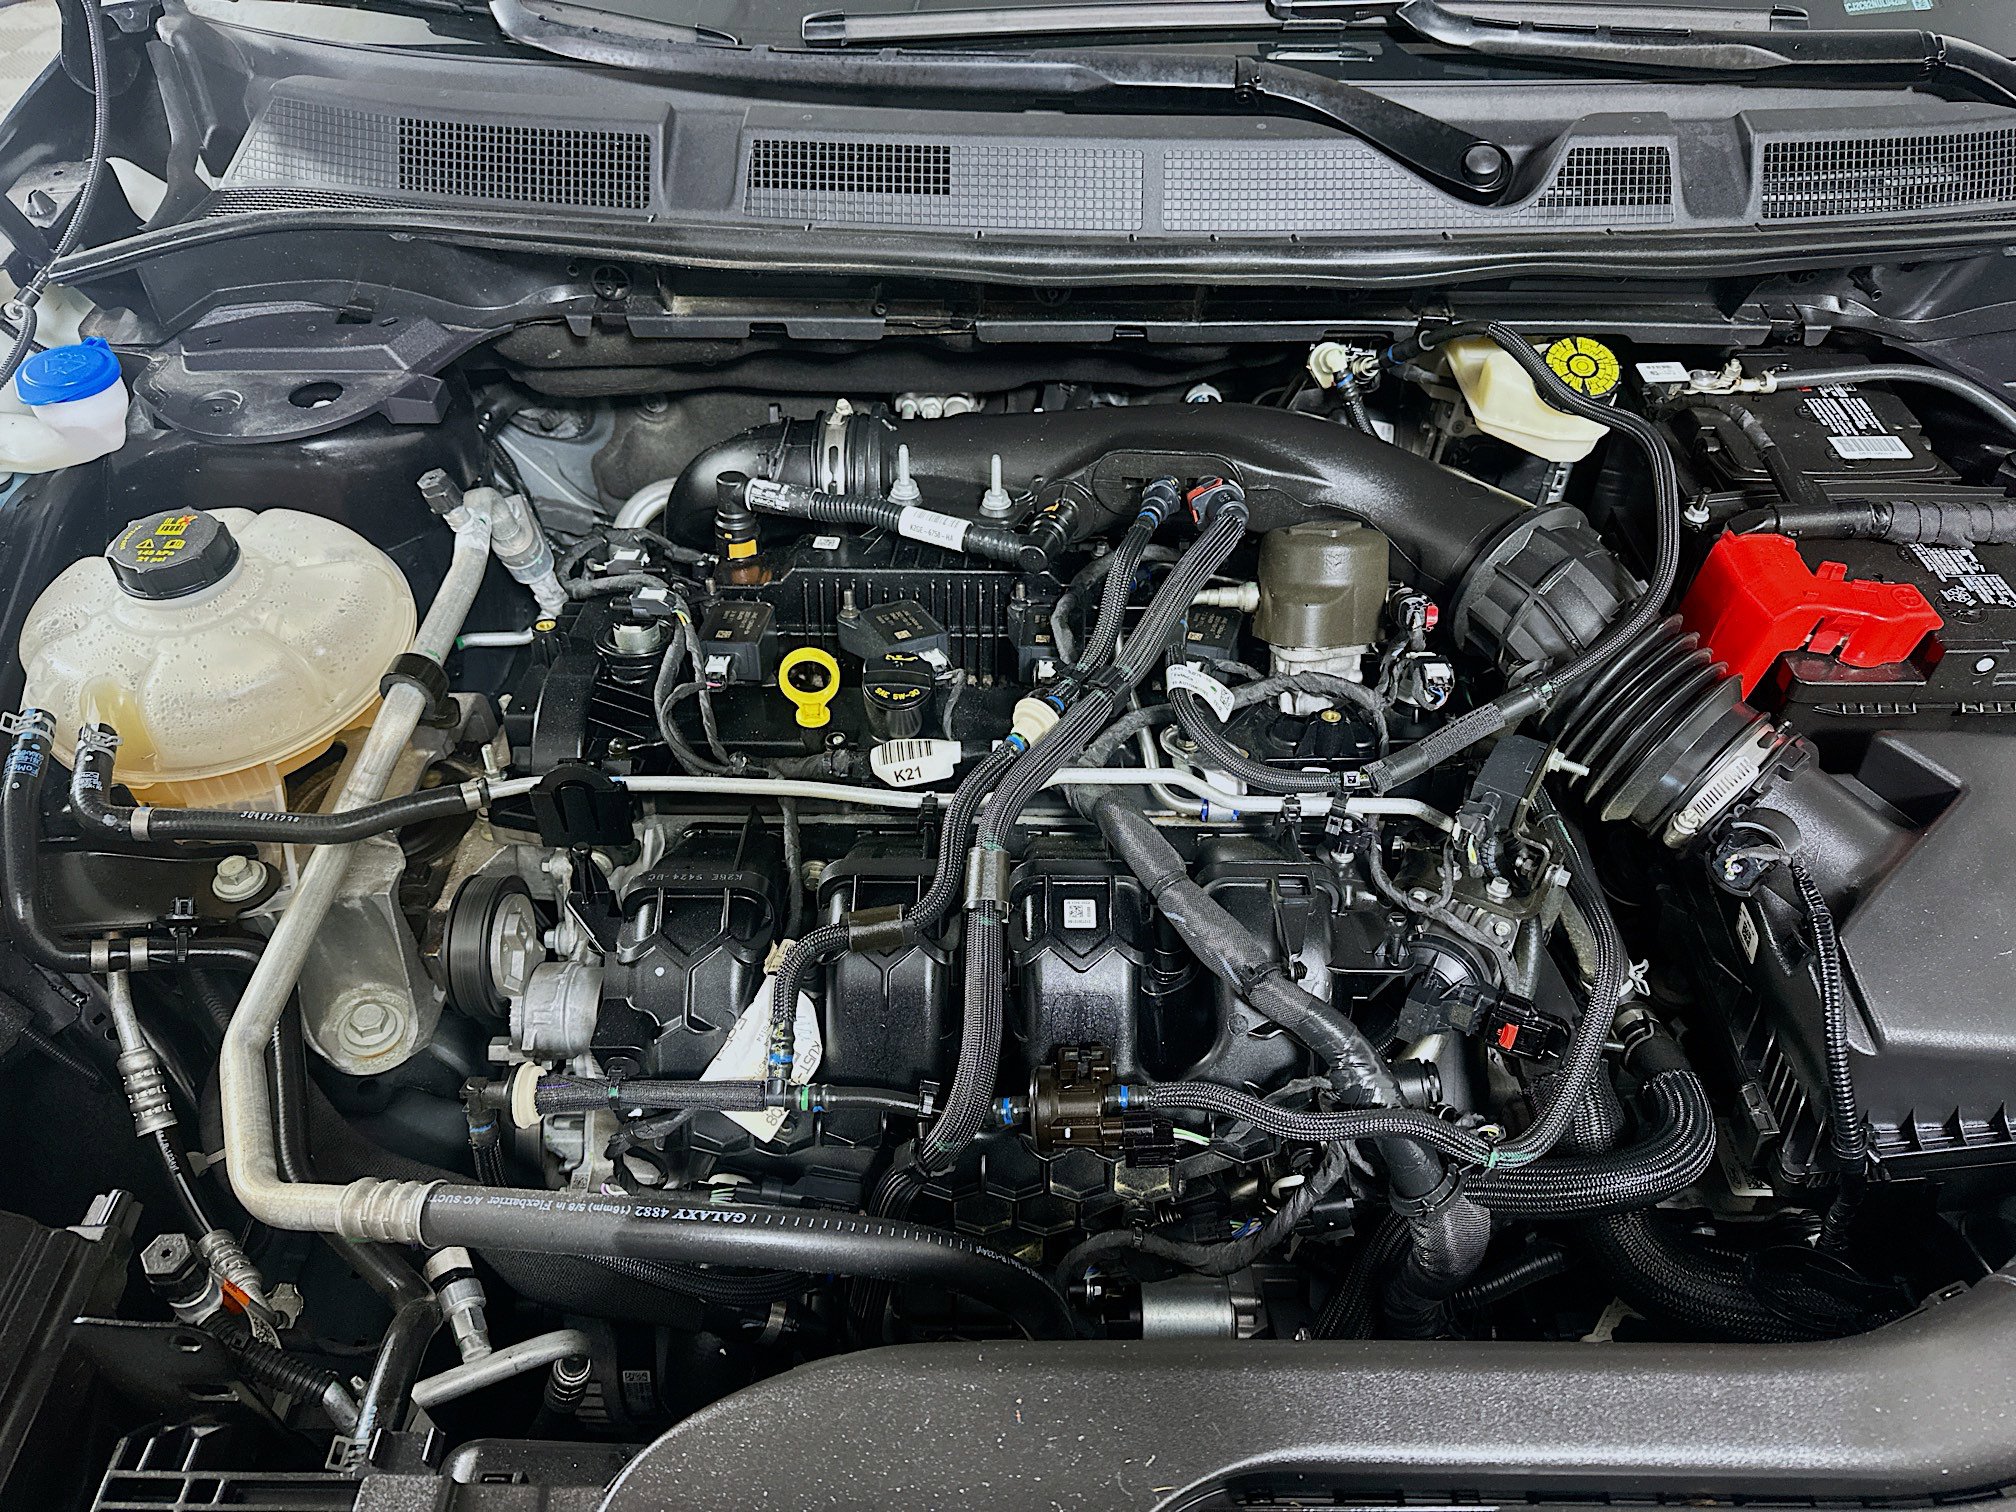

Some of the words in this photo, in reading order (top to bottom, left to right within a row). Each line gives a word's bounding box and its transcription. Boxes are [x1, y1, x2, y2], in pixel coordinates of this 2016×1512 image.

[875, 687, 890, 698] SAE
[892, 688, 920, 700] 5W-30
[894, 766, 922, 782] K21
[463, 1195, 484, 1205] A/C
[487, 1196, 553, 1211] Flexbarrier
[634, 1205, 669, 1219] 4882
[672, 1208, 747, 1224] GALAXY
